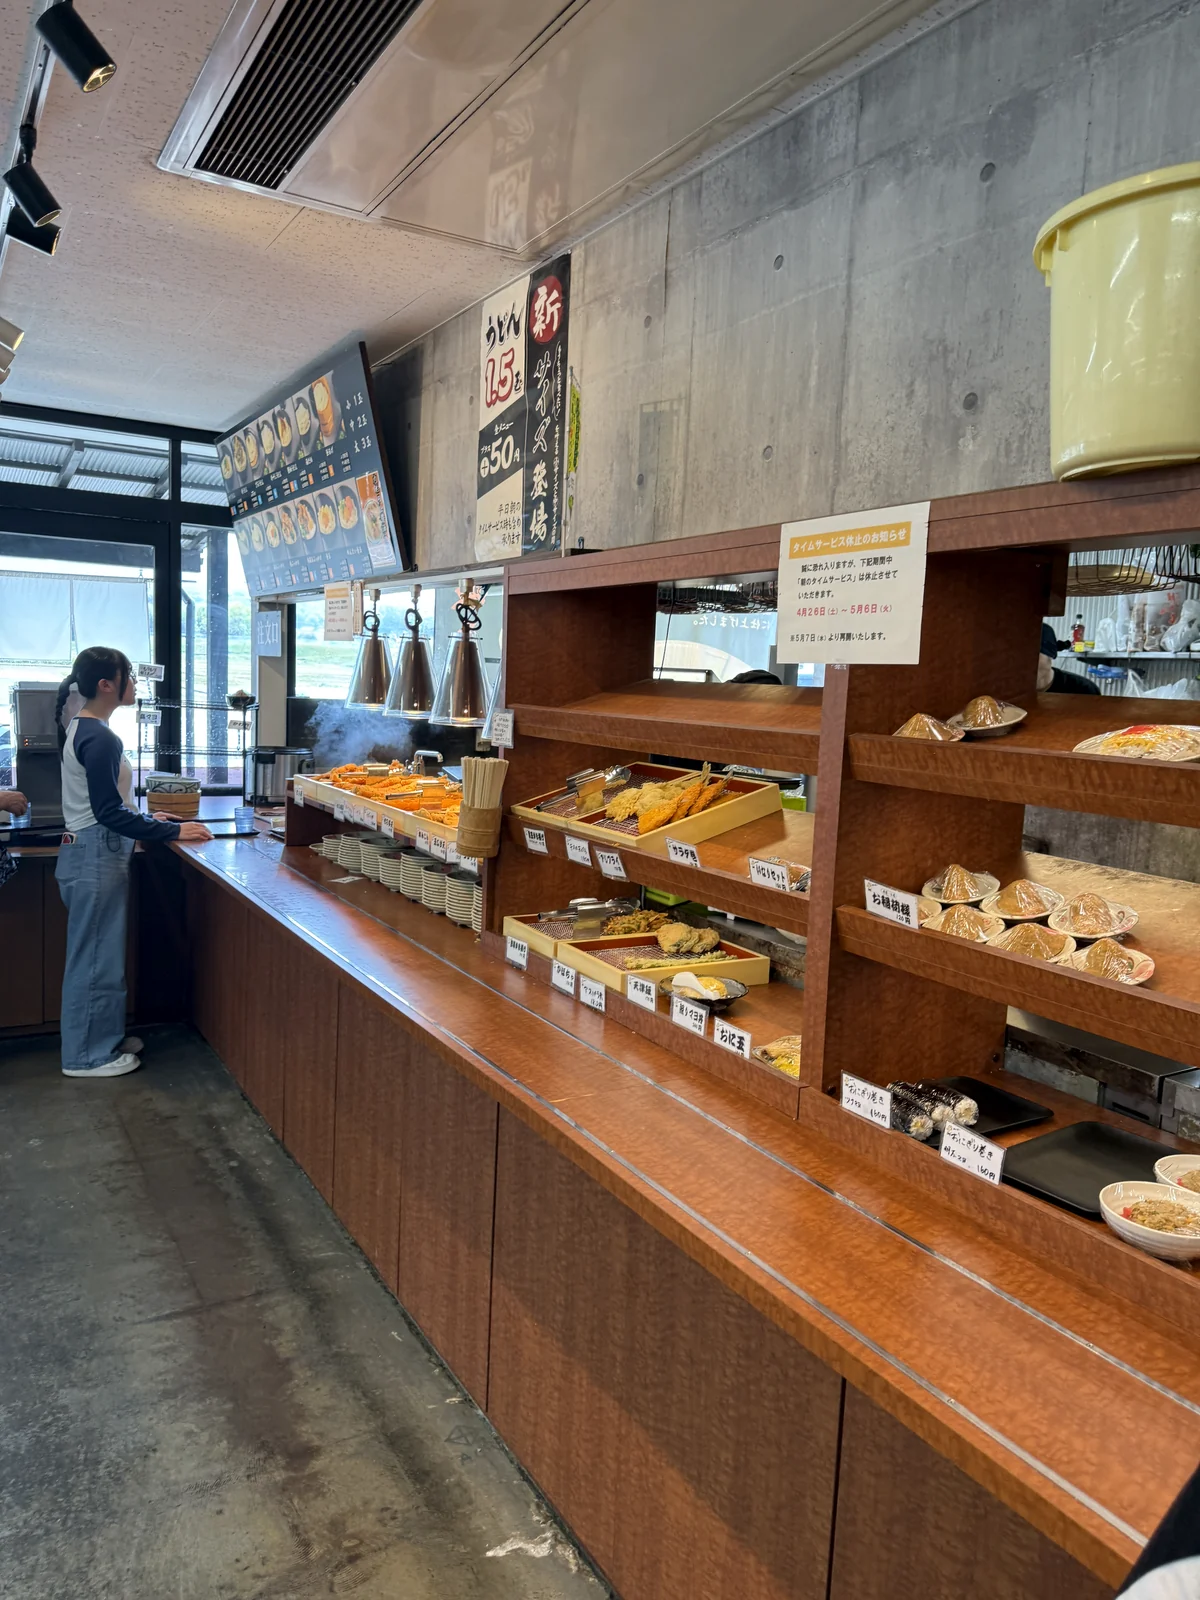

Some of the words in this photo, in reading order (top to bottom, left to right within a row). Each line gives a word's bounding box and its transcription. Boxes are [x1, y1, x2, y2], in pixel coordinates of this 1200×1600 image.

[533, 285, 561, 338] 新
[486, 302, 525, 357] うどん
[494, 422, 514, 435] 全メニュー
[530, 351, 551, 543] サイズ登場
[498, 501, 521, 516] 平日朝の
[501, 532, 521, 547] 承ります
[793, 528, 907, 553] タイムサービス休止のお知らせ
[797, 569, 899, 586] 「朝のタイムサービス」は休止させて
[798, 589, 834, 600] いただきます。
[257, 621, 279, 646] 注文口
[756, 864, 785, 883] いなりセット
[848, 1082, 884, 1105] おにぎり巻き
[870, 1109, 887, 1122] 160円
[950, 1132, 993, 1161] おにぎり巻き
[977, 1164, 996, 1181] 160円
